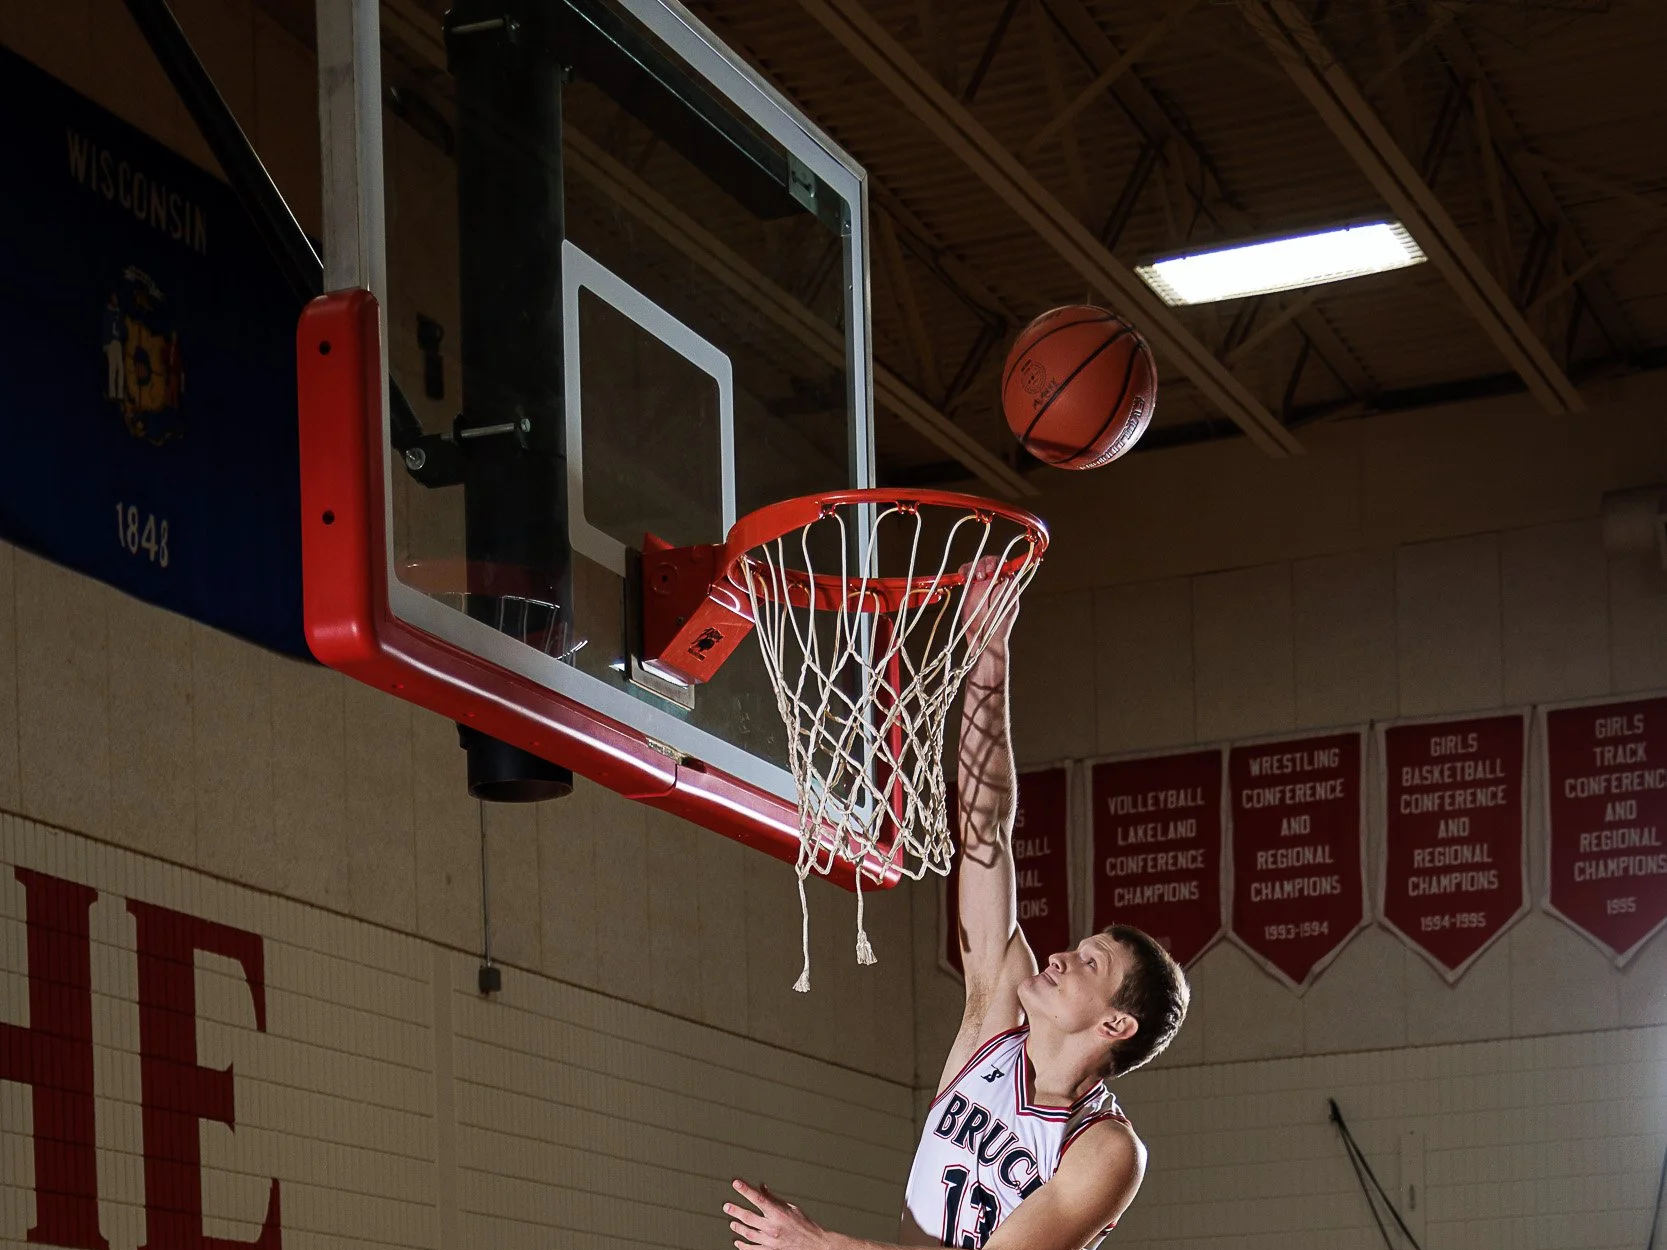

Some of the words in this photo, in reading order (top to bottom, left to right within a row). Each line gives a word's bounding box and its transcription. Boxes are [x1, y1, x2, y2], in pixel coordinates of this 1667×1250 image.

[65, 124, 208, 258] WISCONSIN
[116, 502, 169, 568] 1848
[1595, 714, 1644, 739] GIRLS
[1430, 733, 1478, 757] GIRLS
[1593, 741, 1647, 767] TRACK
[1249, 748, 1340, 777] WRESTLING
[1402, 758, 1505, 787] BASKETBALL
[1242, 778, 1344, 808] CONFERENCE
[1565, 768, 1667, 799] CONFERENC
[1107, 786, 1205, 816] VOLLEYBALL
[1401, 785, 1506, 814] CONFERENCE
[1604, 800, 1637, 823] AND
[1117, 818, 1197, 846] LAKELAND
[1281, 815, 1310, 836] AND
[1438, 817, 1470, 838] AND
[1579, 826, 1662, 853] REGIONAL
[1105, 848, 1206, 877] CONFERENCE
[1256, 846, 1333, 870] REGIONAL
[1413, 846, 1492, 868] REGIONAL
[1573, 854, 1667, 882] CHAMPIONS
[1113, 880, 1200, 908] CHAMPIONS
[1250, 876, 1341, 902] CHAMPIONS
[1408, 870, 1498, 897] CHAMPIONS
[1264, 920, 1329, 940] 1993-1994
[1420, 911, 1486, 932] 1994-1995
[941, 1164, 1002, 1250] 13
